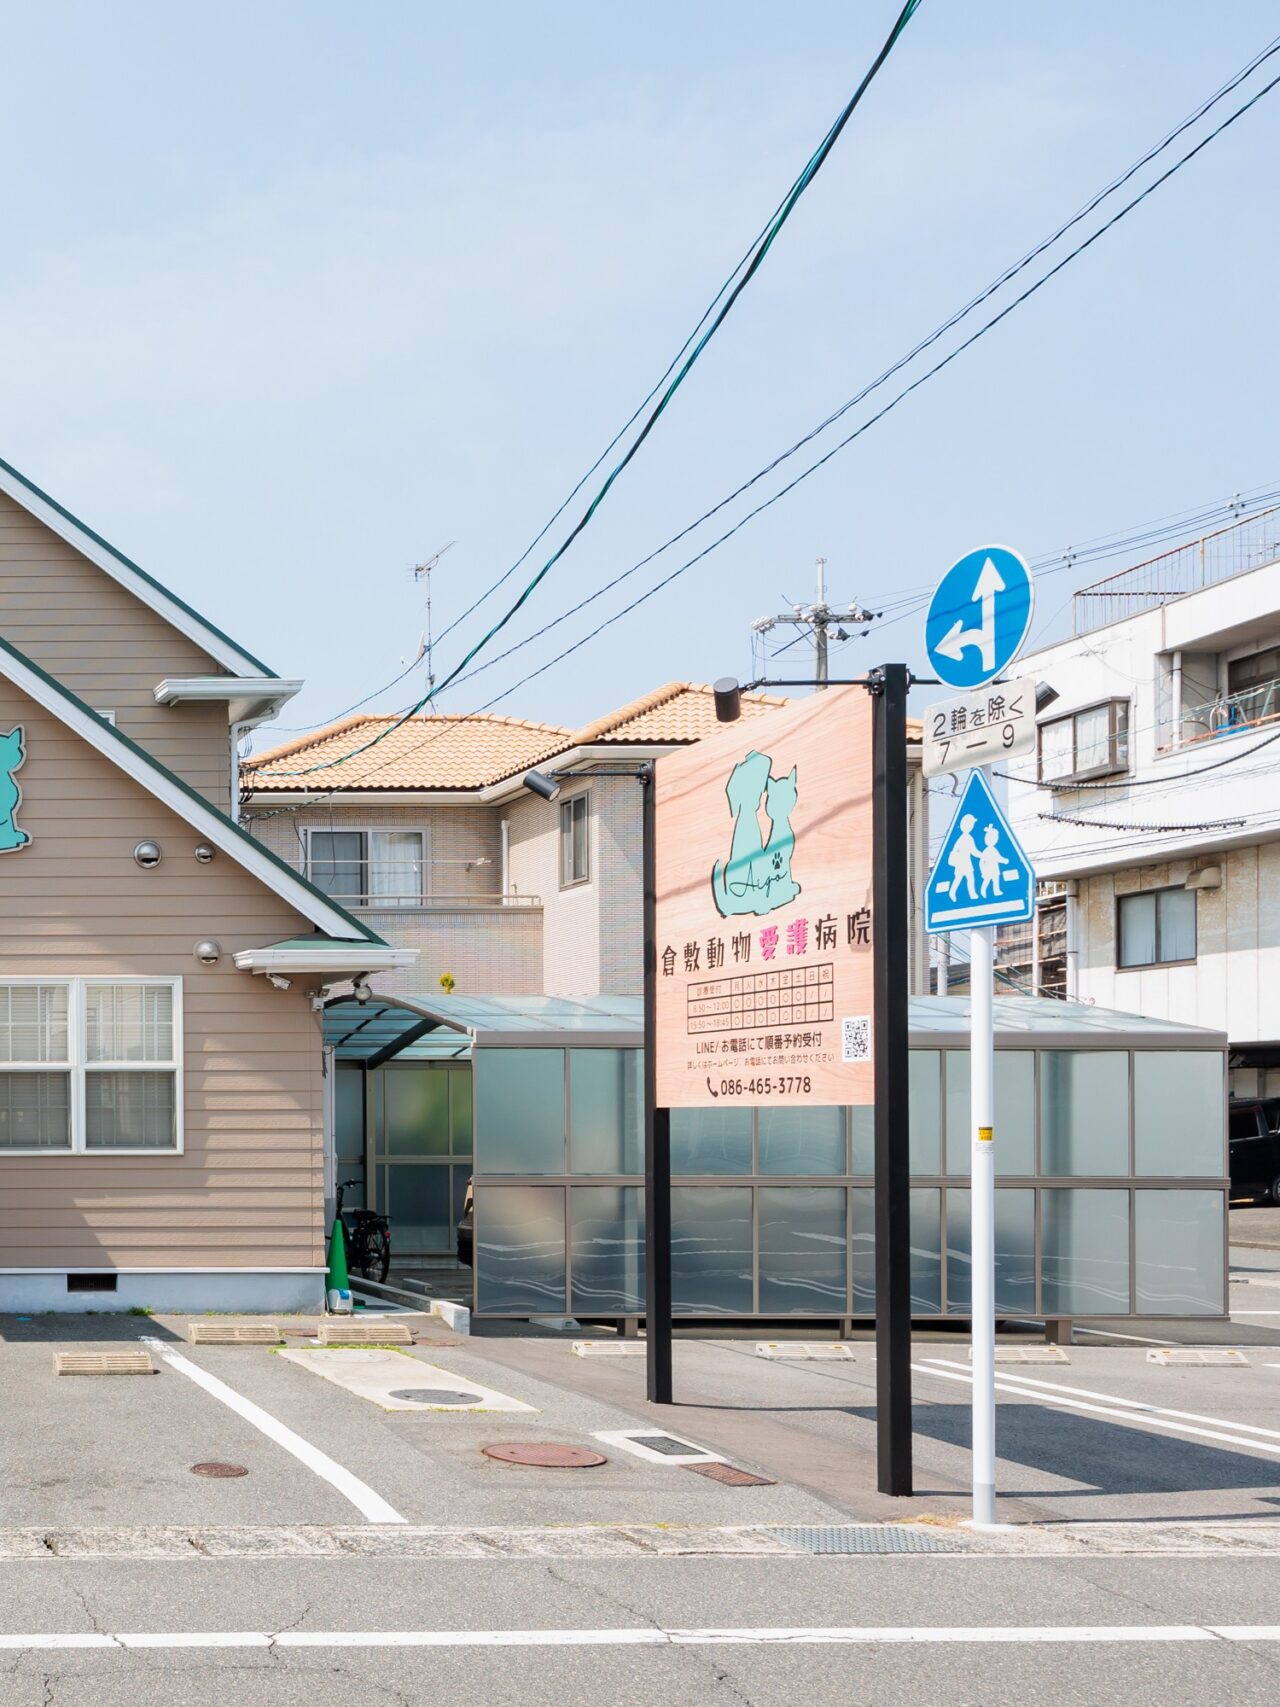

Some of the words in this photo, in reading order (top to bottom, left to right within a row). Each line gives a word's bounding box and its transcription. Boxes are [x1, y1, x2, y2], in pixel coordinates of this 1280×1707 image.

[933, 695, 1024, 737] 2輪を除く
[729, 860, 788, 898] Aigo
[661, 907, 871, 977] 倉敷動物愛護病院
[721, 1076, 811, 1096] 086-465-3778
